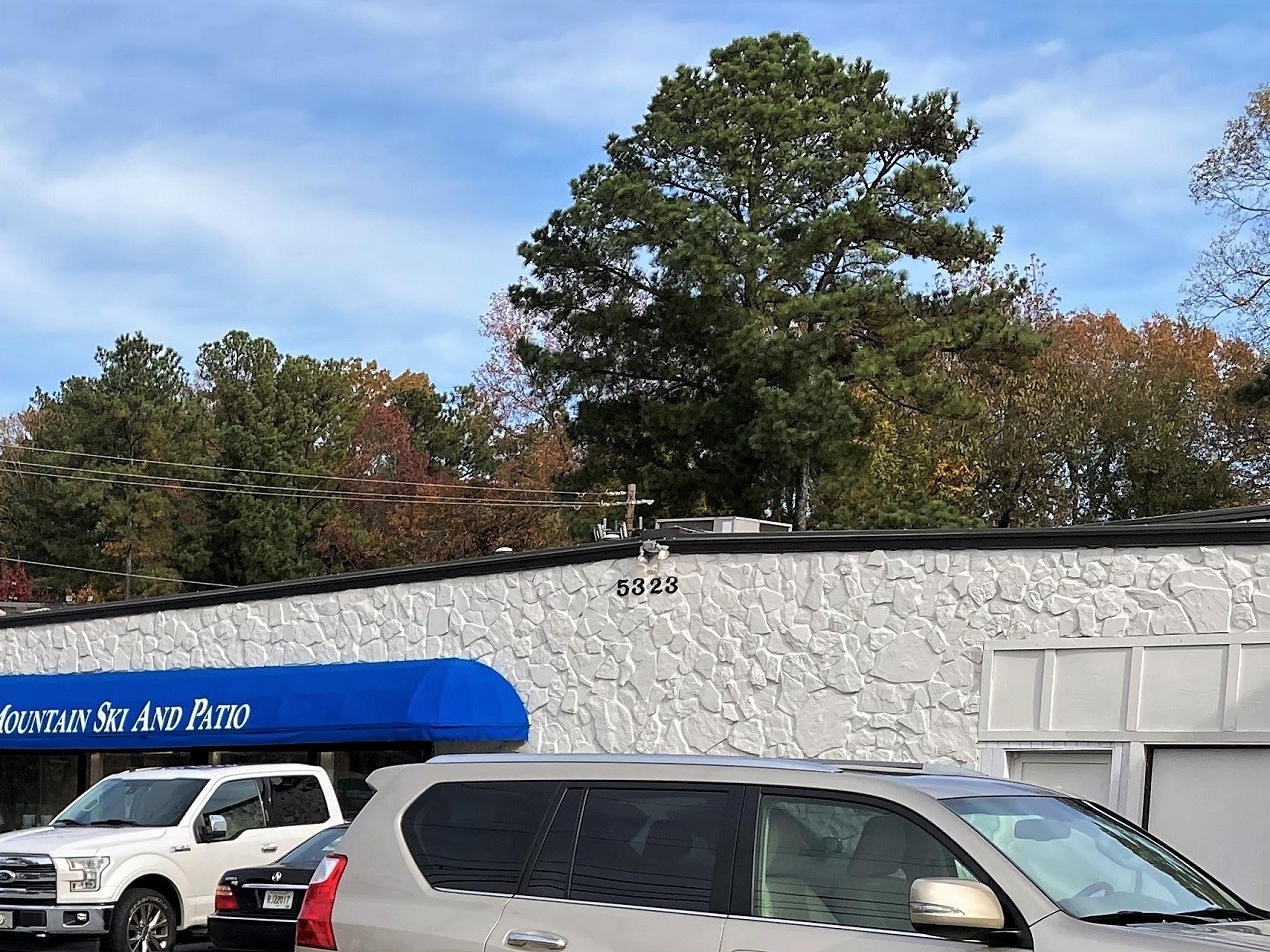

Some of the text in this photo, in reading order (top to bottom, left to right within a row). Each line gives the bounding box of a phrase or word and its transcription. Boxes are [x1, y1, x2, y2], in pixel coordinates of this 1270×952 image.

[616, 576, 679, 597] 5323
[93, 701, 130, 733] SKI
[131, 700, 183, 732] AND
[185, 697, 251, 731] PATIO
